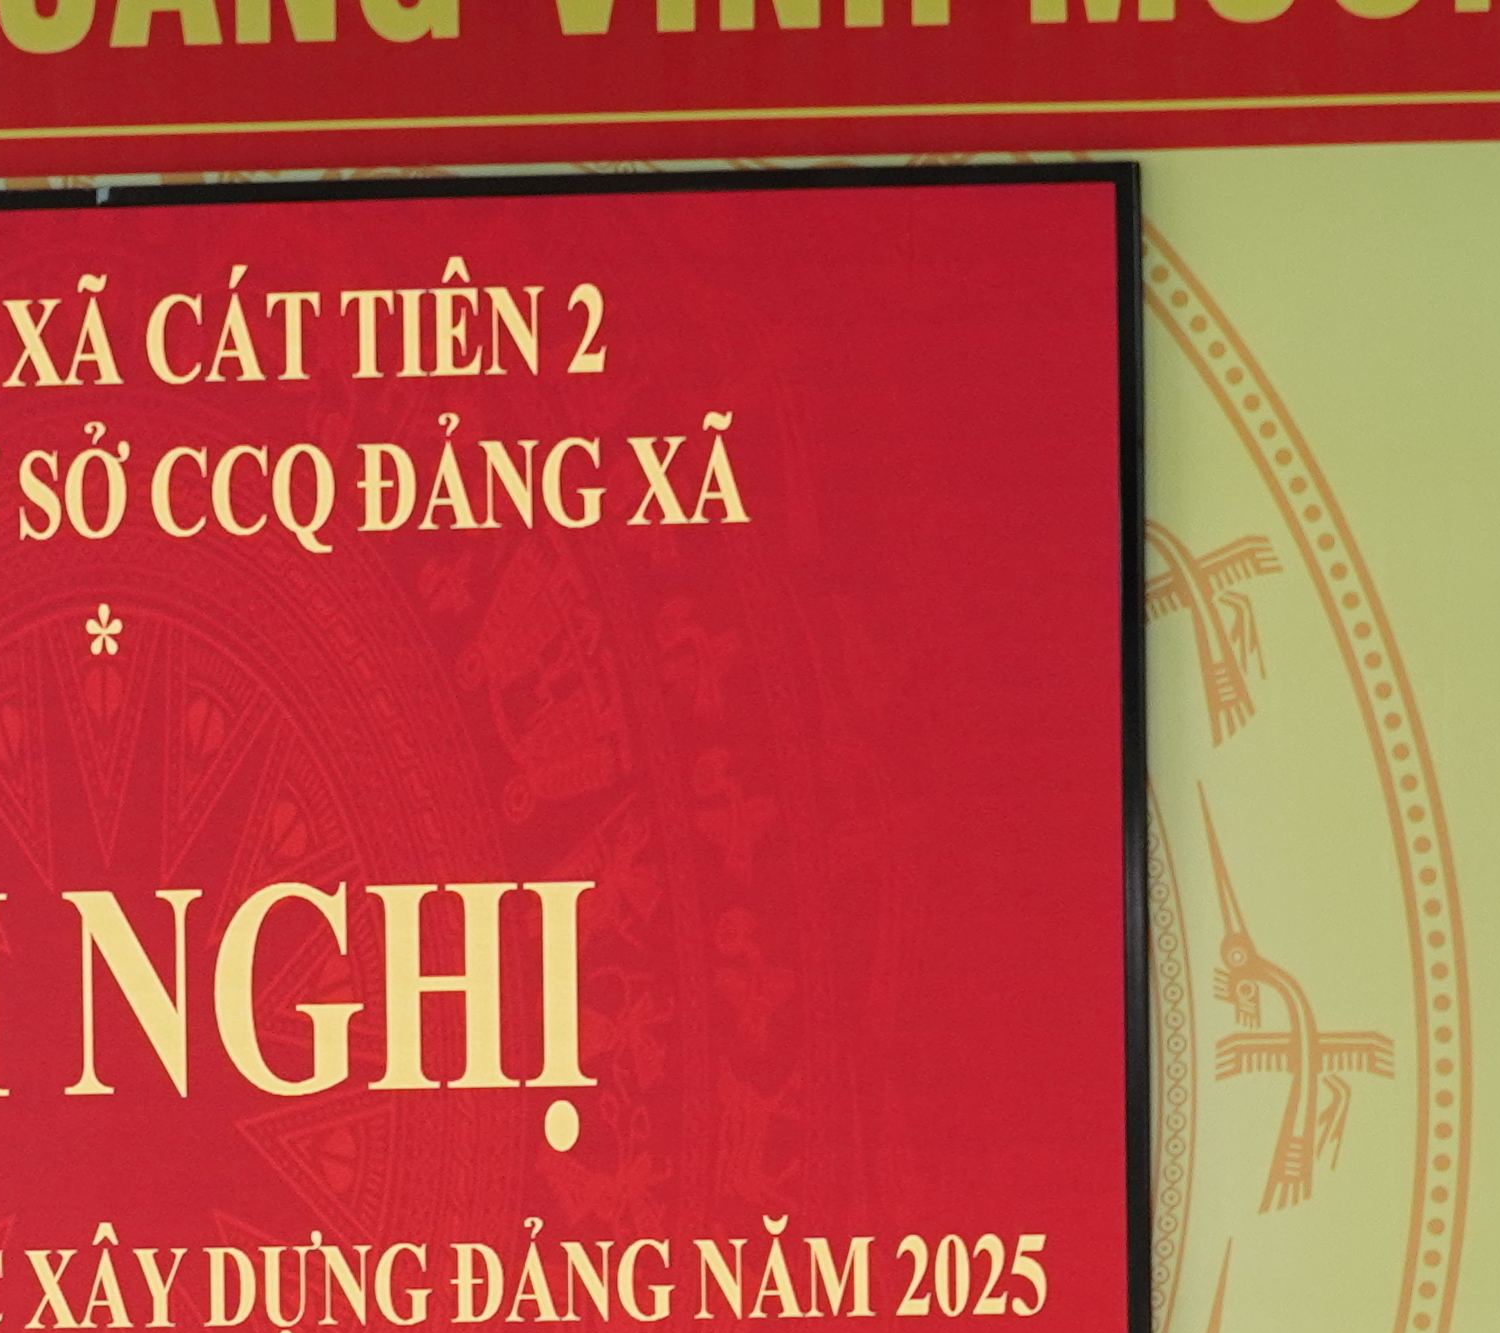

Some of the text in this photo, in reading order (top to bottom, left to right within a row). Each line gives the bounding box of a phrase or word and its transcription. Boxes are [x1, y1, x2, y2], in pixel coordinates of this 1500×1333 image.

[2, 273, 124, 388] XÃ
[145, 264, 321, 385] CÁT
[340, 256, 544, 379] TIÊN
[567, 283, 607, 374] 2
[19, 421, 131, 541] SỞ
[150, 443, 335, 554] CCQ
[356, 412, 607, 532] ĐẢNG
[626, 411, 751, 526] XÃ
[61, 880, 598, 1153] NGHỊ
[24, 1221, 188, 1330] XÂY
[449, 1216, 676, 1324] ĐẢNG
[692, 1214, 876, 1320] NĂM
[895, 1233, 1047, 1318] 2025
